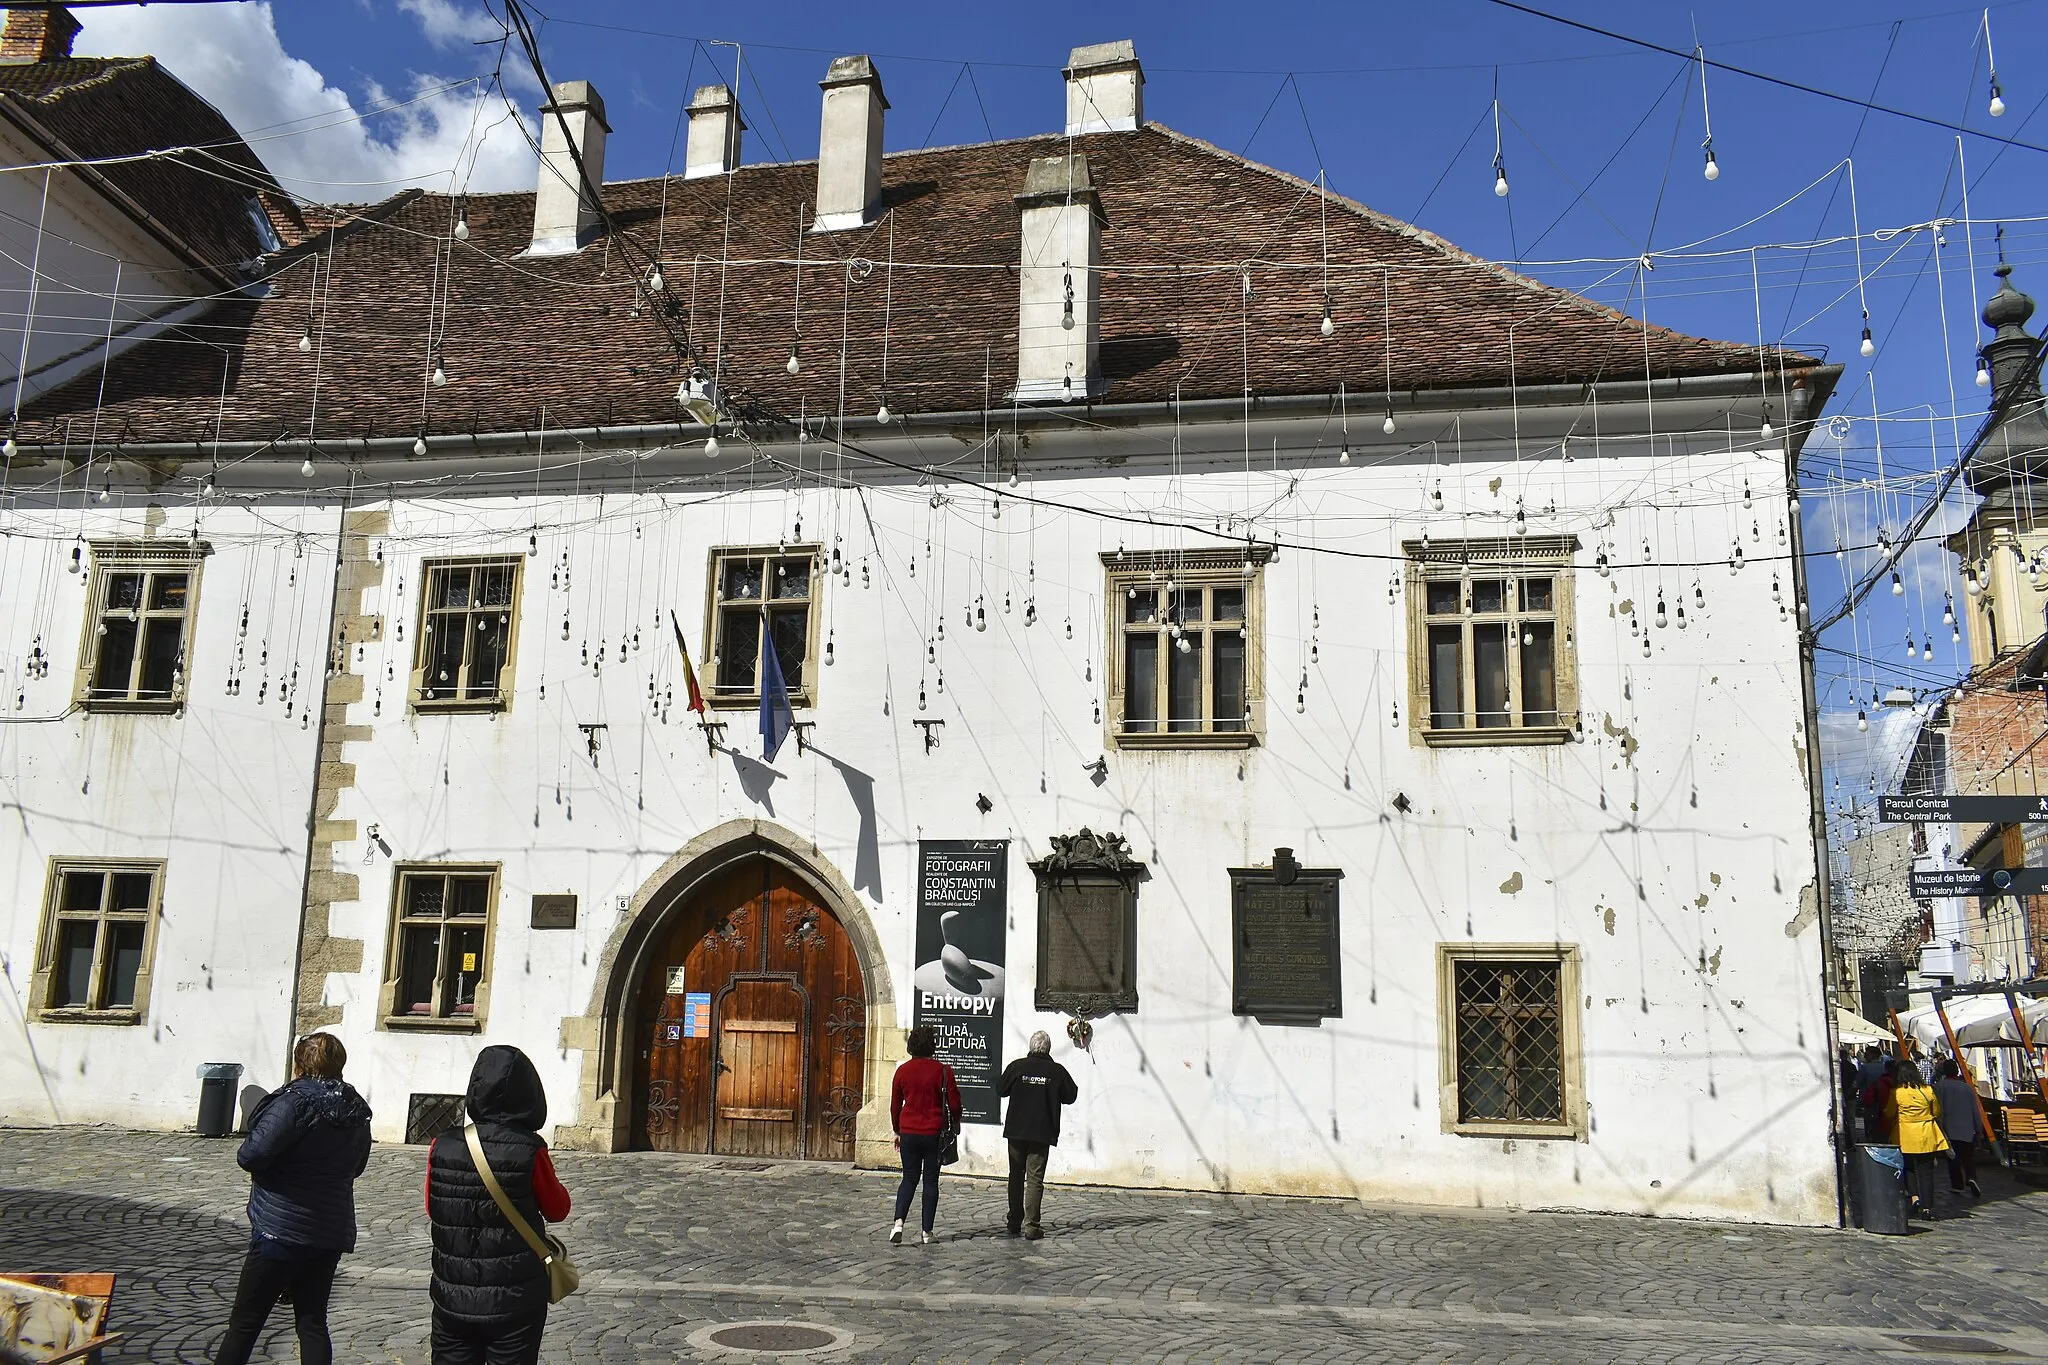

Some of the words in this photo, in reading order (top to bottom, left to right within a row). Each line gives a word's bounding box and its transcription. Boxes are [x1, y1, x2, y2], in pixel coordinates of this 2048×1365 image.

[1885, 799, 1914, 808] Parcul
[1915, 799, 1949, 808] Central
[1887, 812, 1902, 820] The
[1903, 812, 1932, 821] Central
[1933, 811, 1952, 821] Park
[2028, 812, 2041, 820] 500
[926, 860, 991, 872] FOTOGRAFII
[925, 877, 996, 889] CONSTANTIN
[1914, 873, 1942, 884] Muzeul
[1943, 873, 1955, 883] de
[1956, 872, 1981, 882] Istorie
[925, 888, 981, 903] BRÂNCUȘI
[1916, 887, 1929, 895] The
[1929, 886, 1954, 897] History
[1954, 885, 1984, 895] Museum
[922, 991, 996, 1015] Entropy
[934, 1035, 987, 1050] ULPTURĂ
